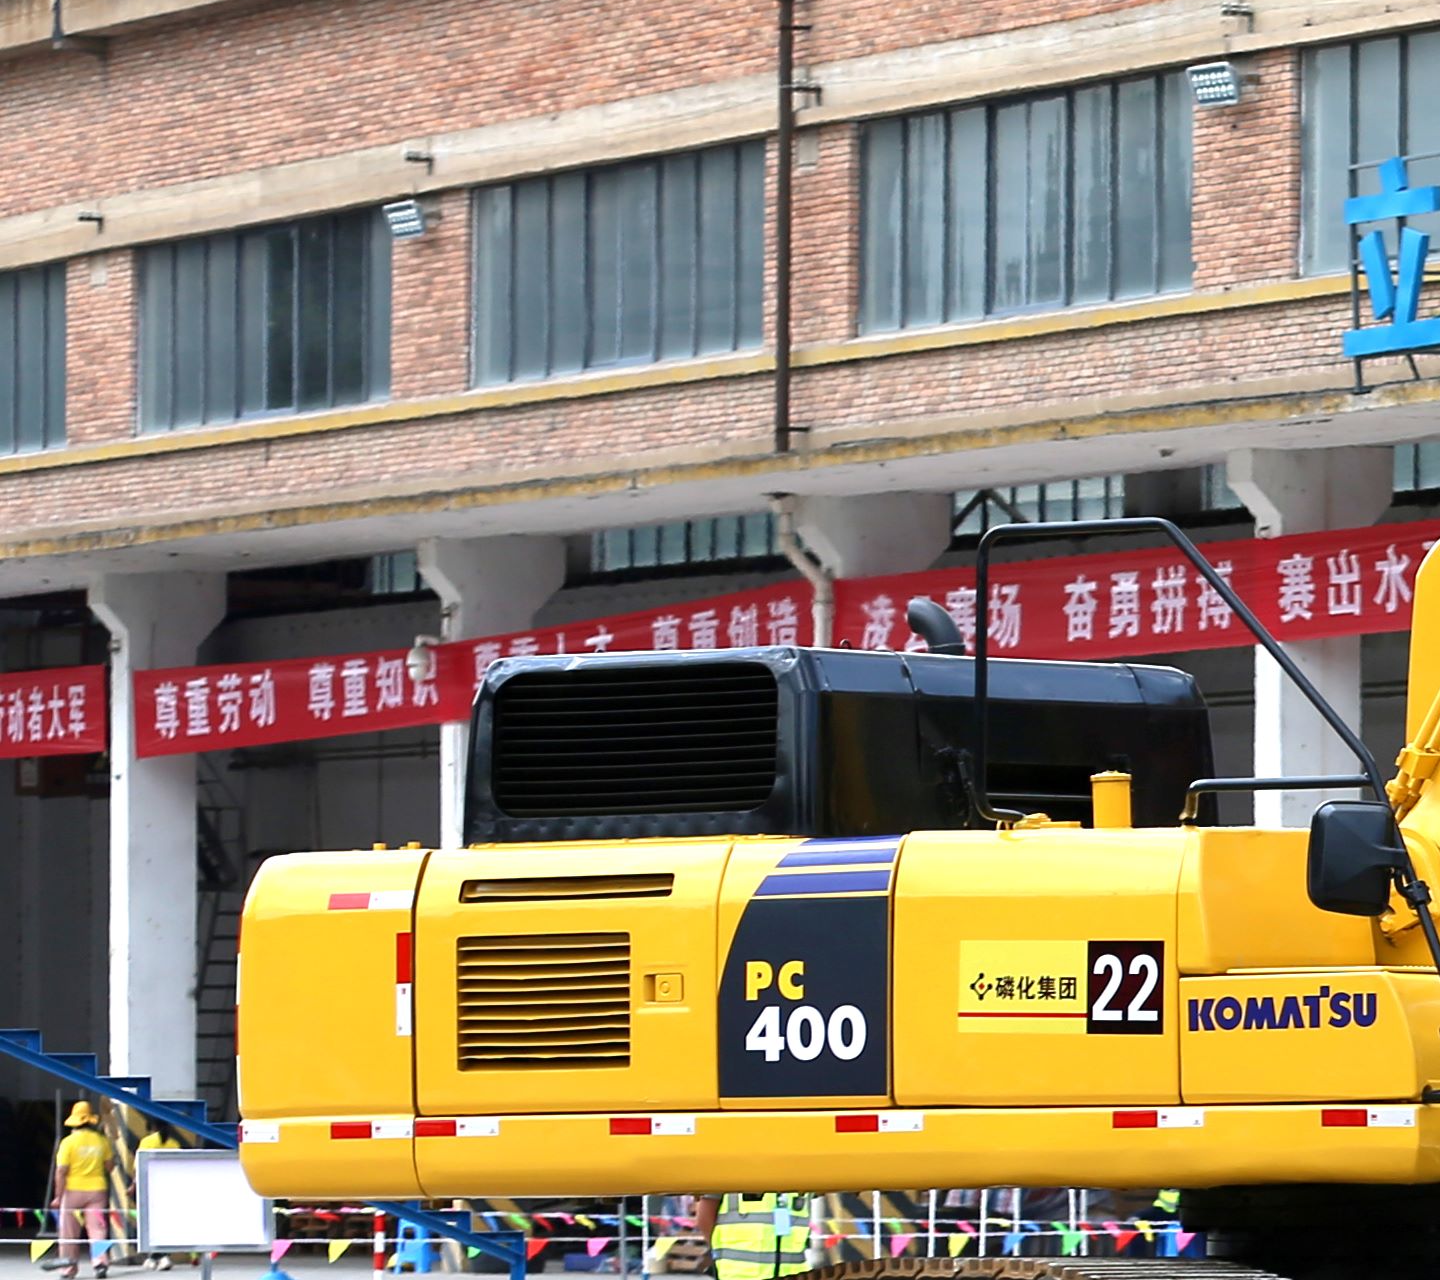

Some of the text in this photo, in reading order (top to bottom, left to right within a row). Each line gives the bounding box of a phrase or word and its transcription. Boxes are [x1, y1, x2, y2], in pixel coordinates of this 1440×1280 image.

[1062, 560, 1234, 643] 奋勇拼搏
[1278, 541, 1434, 624] 赛出水
[0, 684, 86, 743] 动者大军
[154, 669, 277, 740] 尊重劳动
[745, 961, 805, 1001] PC
[995, 975, 1077, 1000] 磷化集团
[1091, 953, 1159, 1021] 22
[1188, 985, 1378, 1032] KOMATSU
[745, 1004, 868, 1062] 400
